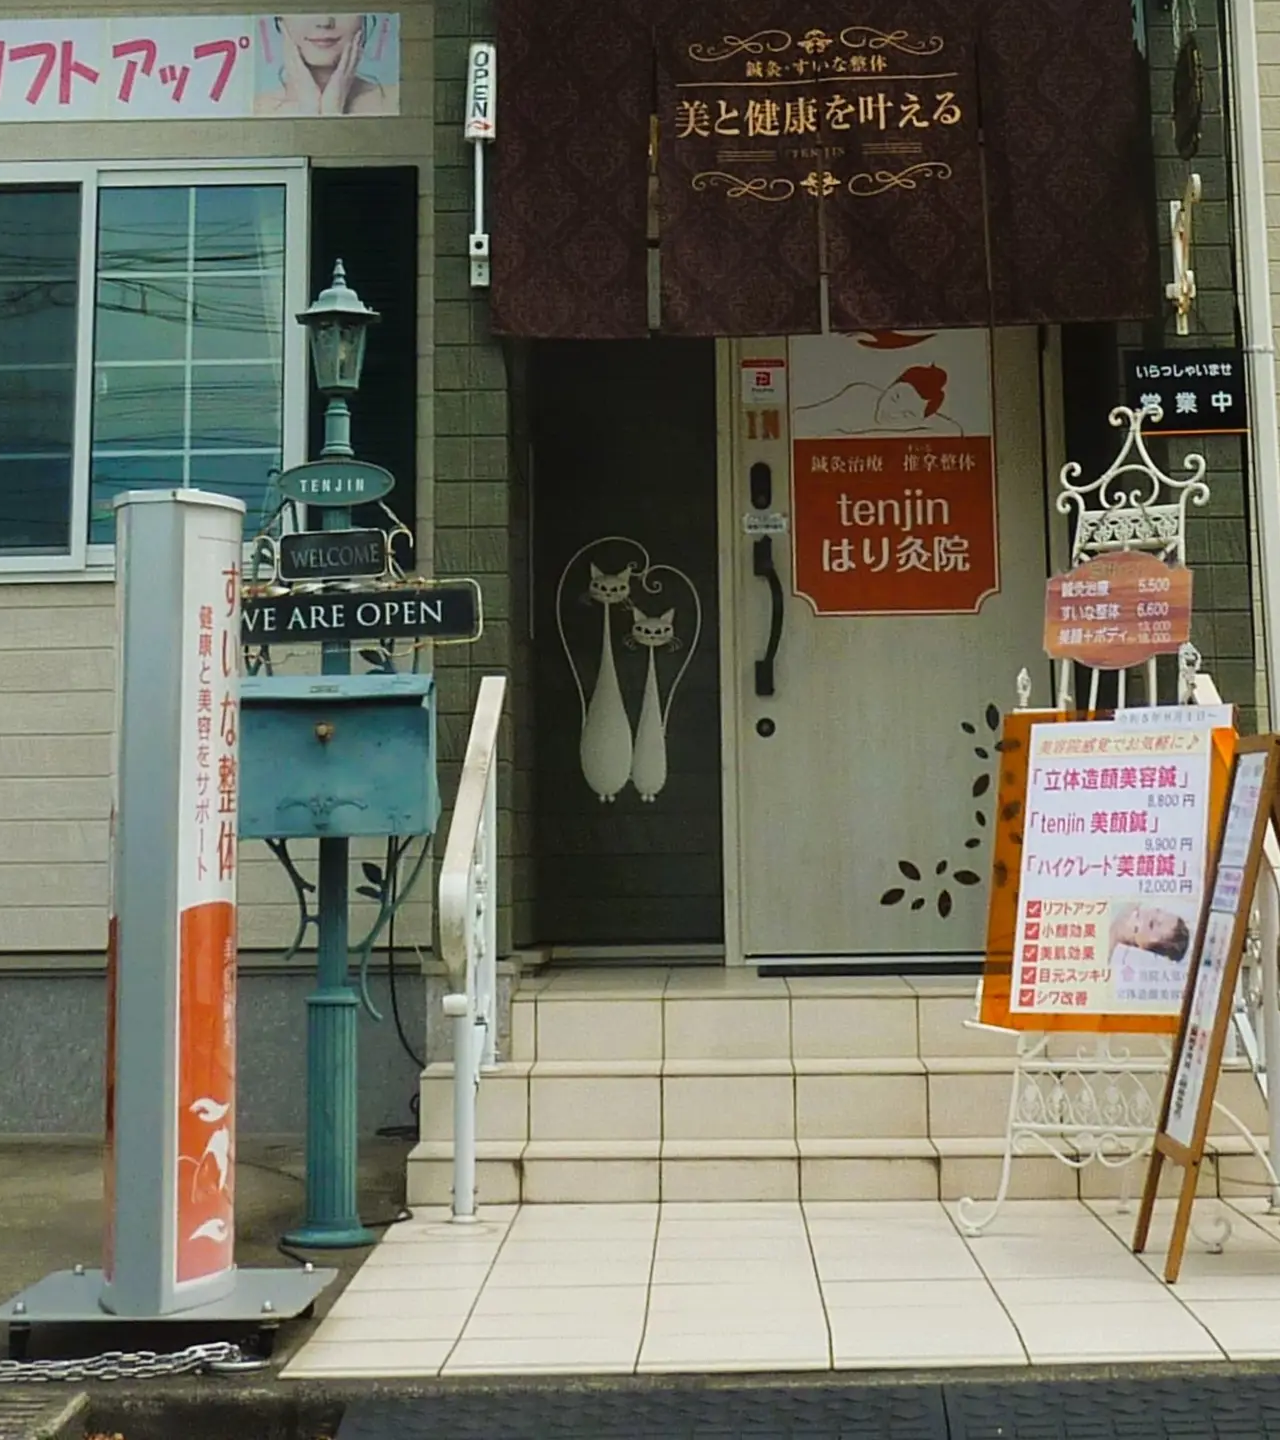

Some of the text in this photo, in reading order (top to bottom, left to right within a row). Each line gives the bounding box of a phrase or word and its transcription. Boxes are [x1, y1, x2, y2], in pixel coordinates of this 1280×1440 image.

[472, 51, 489, 119] OPEN
[675, 91, 962, 138] 美と健康を叶える
[1136, 363, 1233, 378] いらっしゃいませ
[1140, 390, 1233, 414] 営業中
[299, 478, 365, 493] TENJIN
[836, 489, 949, 531] tenjin
[291, 543, 380, 569] WELCOME
[822, 536, 970, 573] はり灸院
[286, 604, 345, 630] ARE
[356, 599, 443, 627] OPEN
[216, 561, 240, 883] すいな整体
[195, 605, 214, 881] 健康と美容をサポート
[1043, 901, 1108, 916] リフトアップ
[1039, 968, 1112, 984] 目元スッキリ
